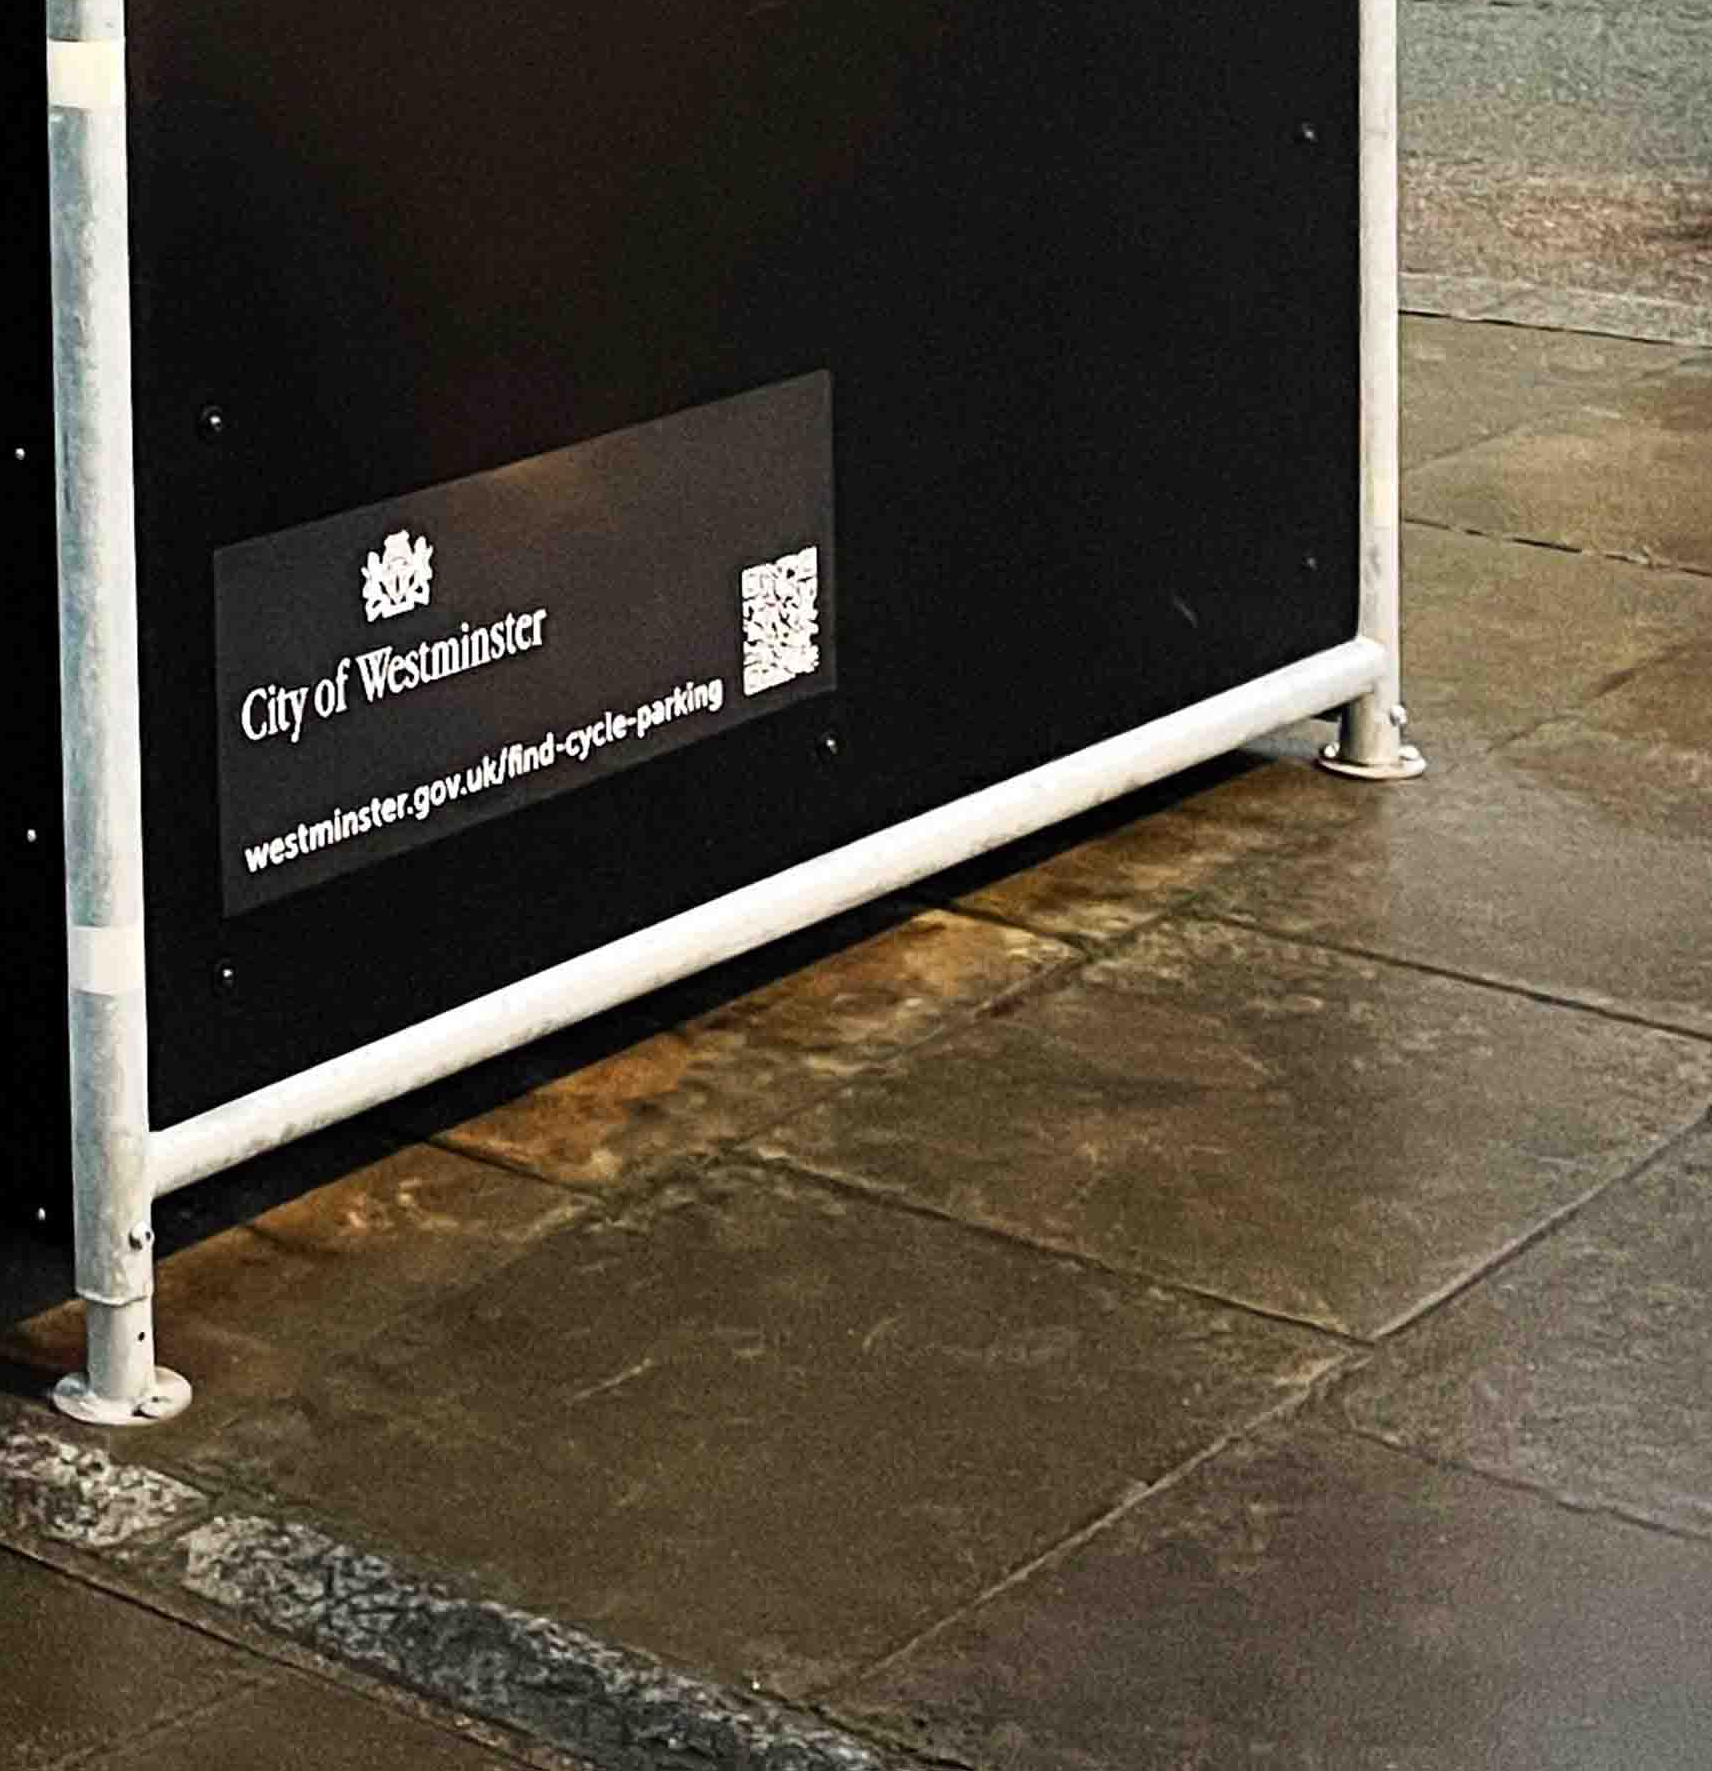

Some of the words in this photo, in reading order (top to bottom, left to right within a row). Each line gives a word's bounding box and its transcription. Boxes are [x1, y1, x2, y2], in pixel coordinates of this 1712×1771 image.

[239, 683, 308, 743] City
[314, 659, 352, 719] of
[356, 608, 548, 705] Westminster
[243, 677, 725, 873] westminster.gov.uk/find-cycle-parking
